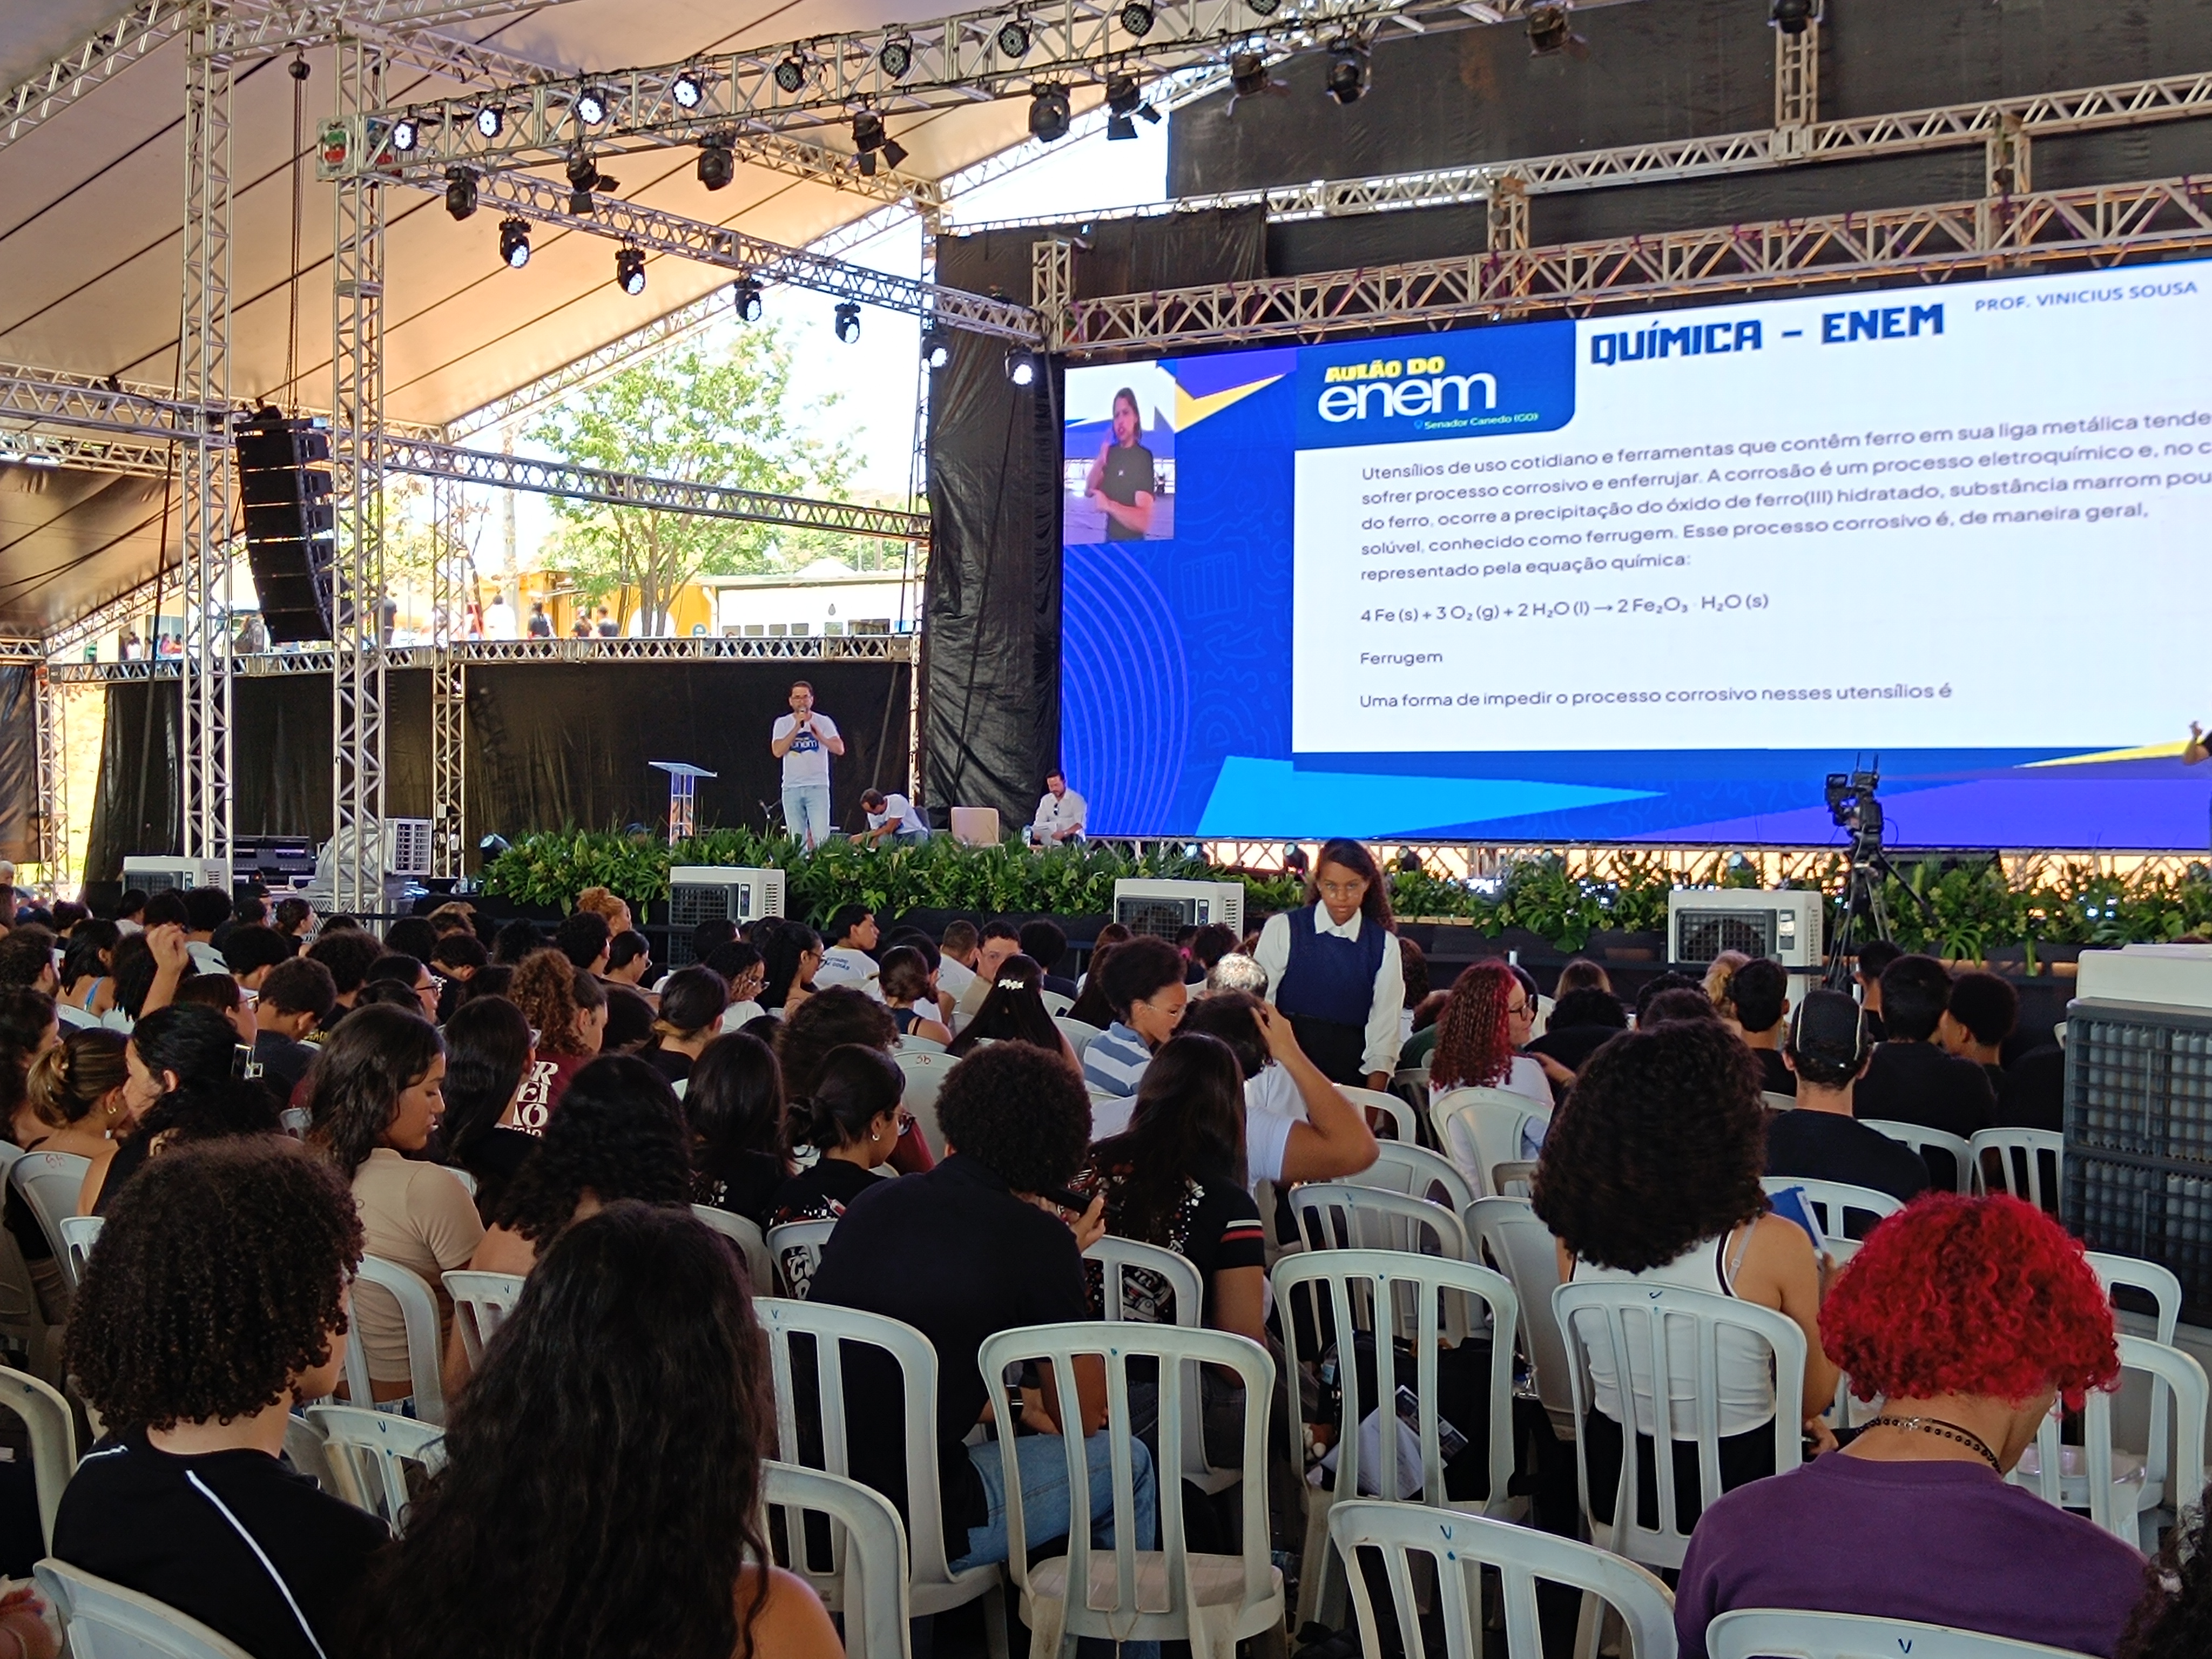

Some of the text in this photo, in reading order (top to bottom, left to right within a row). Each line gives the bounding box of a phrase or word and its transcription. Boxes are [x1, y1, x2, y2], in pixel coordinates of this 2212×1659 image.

[1975, 281, 2197, 312] PROF. VINICIUS SOUSA
[1591, 320, 1762, 367] QUÍMICA
[1821, 303, 1944, 345] ENEM
[1325, 356, 1445, 382] AULÃO DO
[1318, 373, 1496, 422] enem
[1424, 412, 1539, 429] Senador Canedo (GO)
[1363, 463, 1444, 480] Utensílios
[1448, 461, 1471, 474] de
[1474, 461, 1507, 473] uso
[1510, 454, 1598, 470] cotidiano
[1602, 453, 1613, 464] e
[1617, 444, 1734, 462] ferramentas
[1738, 441, 1777, 456] que
[1781, 434, 1860, 452] contêm
[1865, 431, 1915, 446] ferro
[1919, 430, 1953, 443] em
[1958, 427, 1994, 441] sua
[1999, 424, 2038, 441] liga
[2042, 416, 2138, 434] metálica
[1363, 490, 1412, 505] sofrer
[1415, 487, 1499, 504] processo
[1502, 480, 1588, 496] corrosivo
[1592, 480, 1603, 490] e
[1608, 472, 1702, 489] enferrujar.
[1707, 469, 1721, 482] A
[1724, 464, 1815, 482] corrosão
[1819, 461, 1832, 476] é
[1837, 463, 1868, 475] um
[1873, 456, 1974, 476] processo
[1978, 446, 2134, 467] eletroquímico
[2138, 446, 2158, 457] e,
[2164, 443, 2193, 455] no
[1361, 517, 1385, 530] do
[1388, 516, 1433, 528] ferro,
[1438, 512, 1497, 525] ocorre
[1500, 512, 1510, 522] a
[1515, 502, 1633, 524] precipitação
[1637, 501, 1663, 514] do
[1667, 497, 1721, 512] óxido
[1725, 495, 1751, 509] de
[1756, 490, 1833, 507] ferro(III)
[1837, 484, 1944, 502] hidratado,
[1950, 477, 2068, 497] substância
[2073, 475, 2161, 489] marrom
[1361, 502, 2148, 555] solúvel, conhecido como ferrugem. Esse processo corrosivo é, de maneira geral,
[1361, 554, 1690, 582] representado pela equação química:
[1361, 610, 1371, 622] 4
[1375, 609, 1395, 622] Fe
[1399, 608, 1418, 623] (s)
[1422, 611, 1432, 619] +
[1437, 606, 1446, 620] 3
[1476, 605, 1499, 621] (g)
[1503, 608, 1513, 616] +
[1518, 603, 1528, 617] 2
[1618, 599, 1628, 613] 2
[1745, 594, 1769, 610] (s)
[1360, 652, 1442, 667] Ferrugem
[1360, 683, 1952, 707] Uma forma de impedir o processo corrosivo nesses utensílios é
